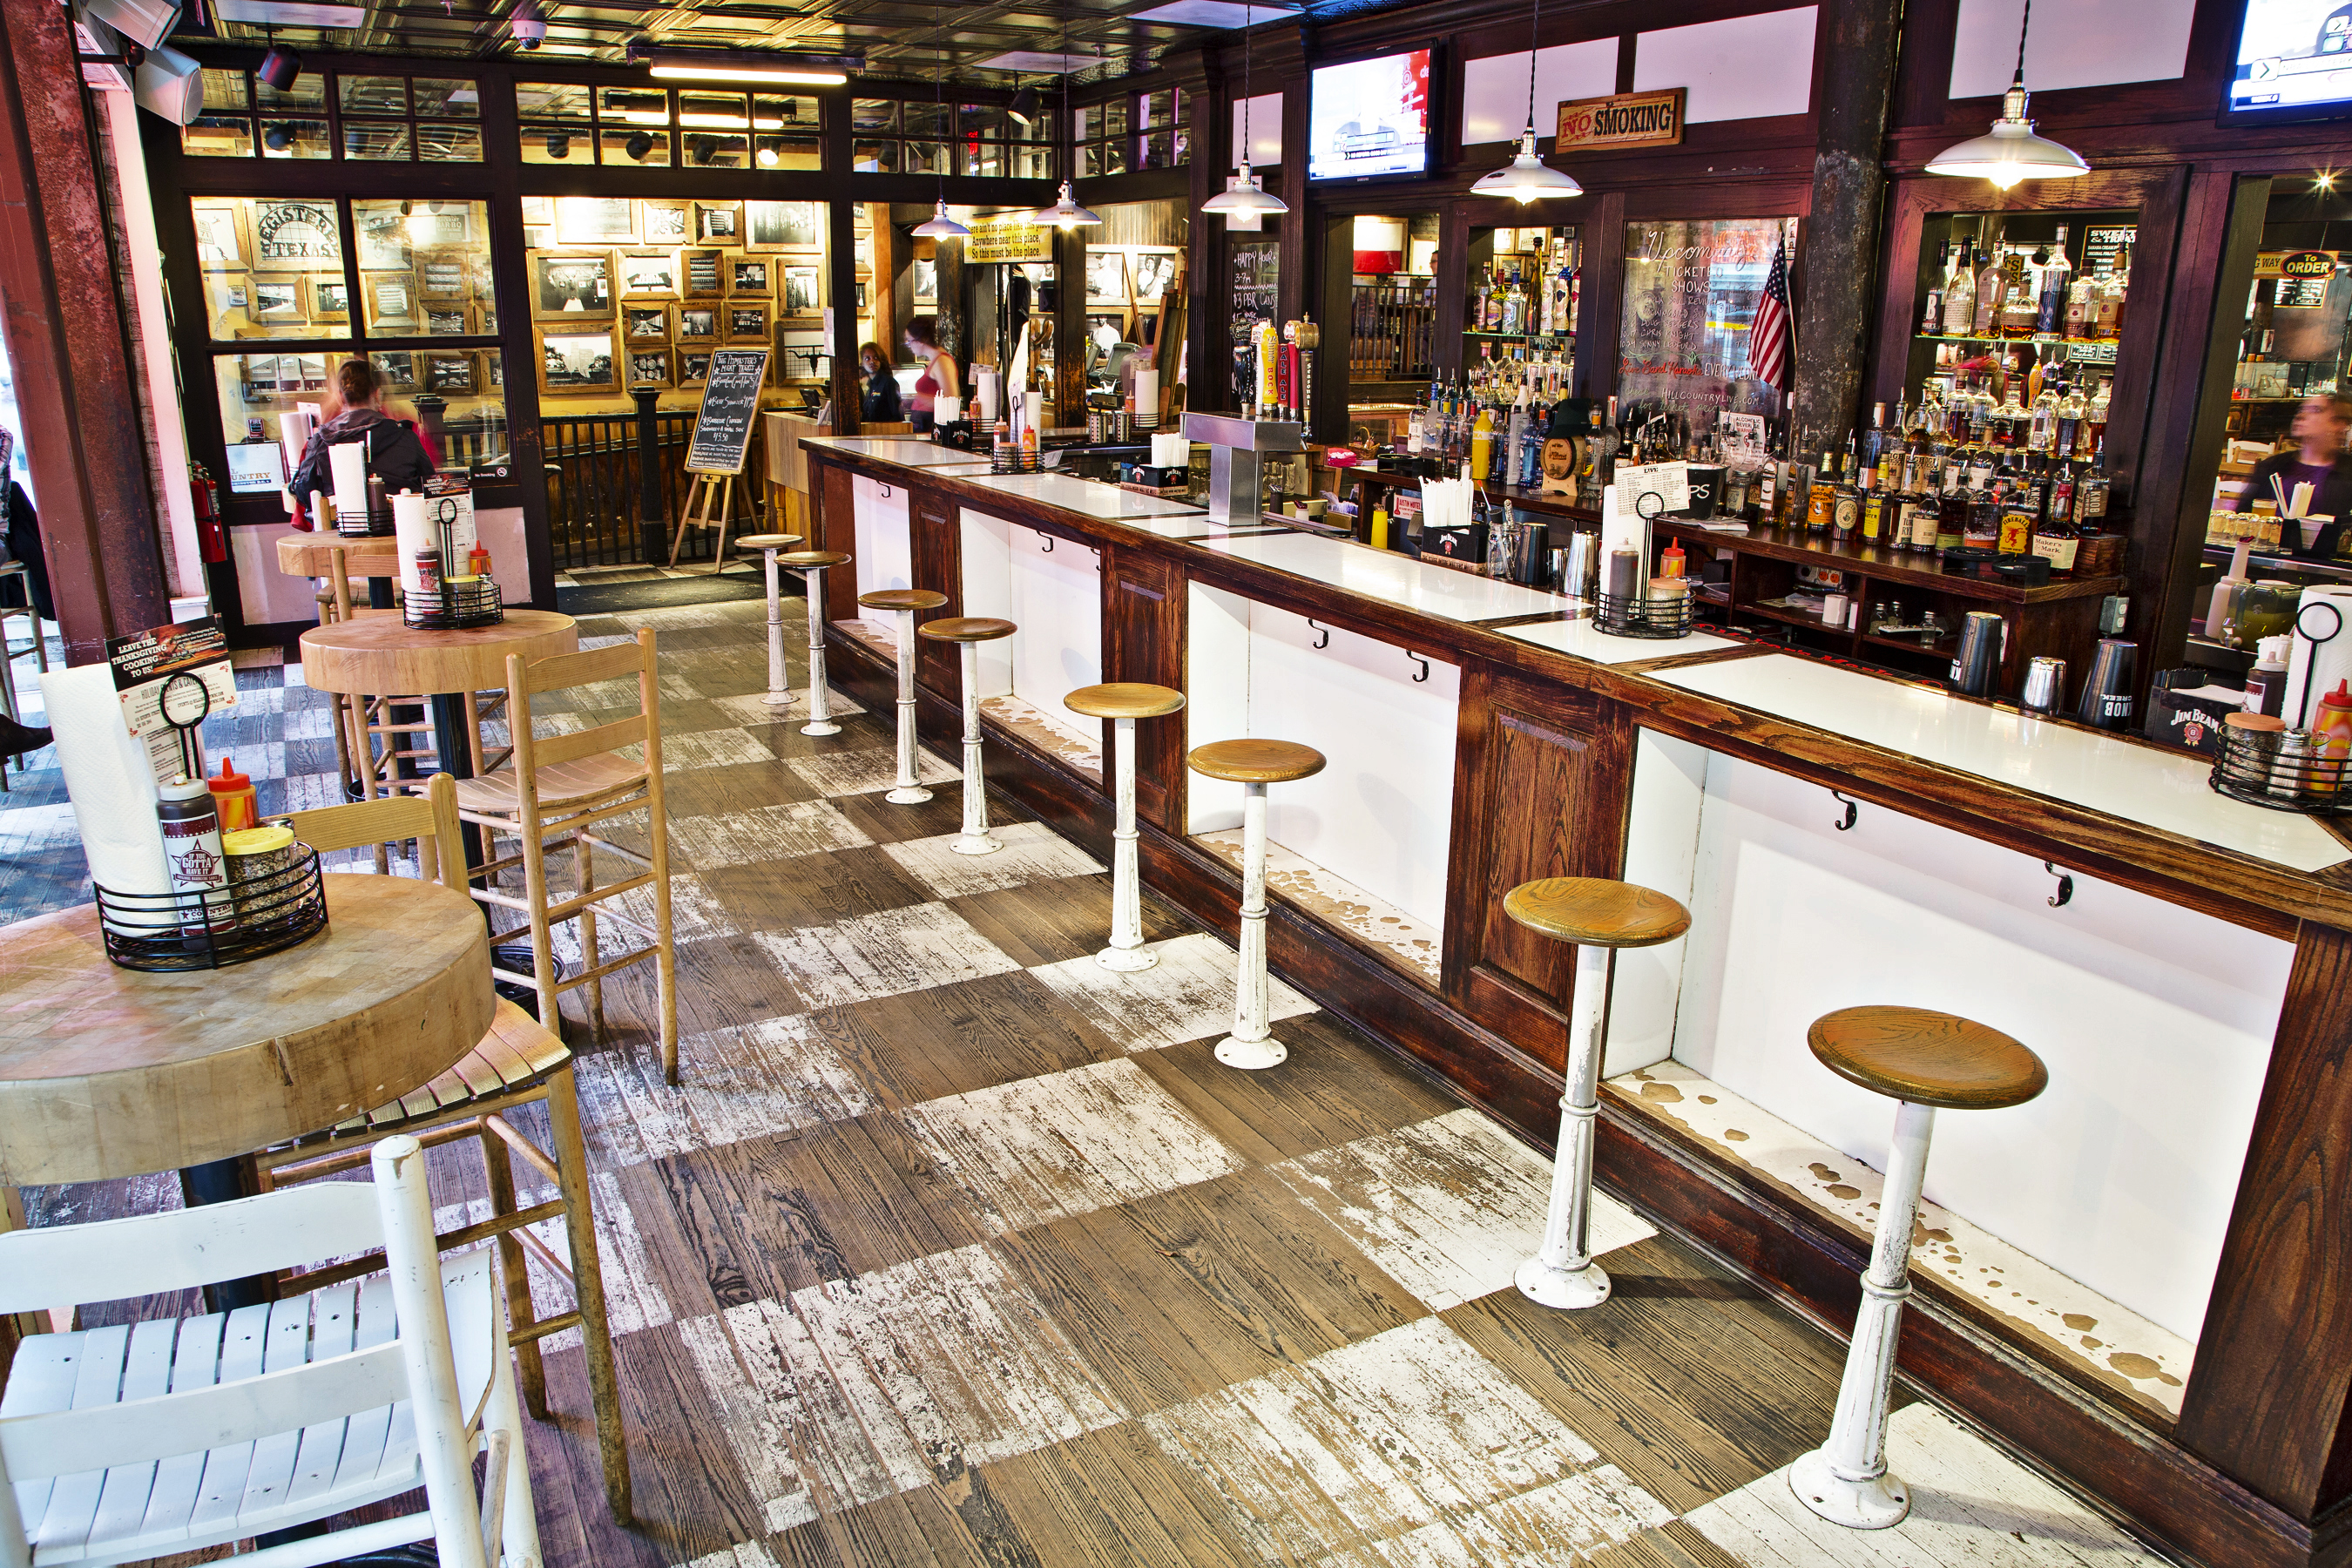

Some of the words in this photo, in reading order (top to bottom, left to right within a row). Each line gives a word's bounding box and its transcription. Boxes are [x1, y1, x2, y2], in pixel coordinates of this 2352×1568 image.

[1562, 115, 1592, 138] NO
[1594, 103, 1671, 136] SMOKING
[979, 221, 990, 233] ain't
[992, 224, 997, 233] no
[999, 220, 1012, 234] place
[1013, 220, 1023, 231] like
[1024, 219, 1034, 230] this
[972, 235, 998, 248] Anywhere
[999, 235, 1010, 245] near
[1012, 233, 1023, 244] this
[1024, 232, 1040, 246] place,
[272, 241, 335, 257] TEXAS
[972, 248, 978, 259] So
[979, 247, 990, 259] this
[990, 248, 1004, 258] must
[1005, 247, 1011, 257] be
[1013, 247, 1022, 257] the
[1024, 246, 1041, 260] place.
[1648, 231, 1747, 272] Upcoming
[1238, 249, 1257, 273] HAPPY
[1258, 248, 1277, 268] HOUR
[2264, 257, 2281, 267] WAY
[2287, 261, 2329, 274] ORDER
[1664, 266, 1723, 278] TICKETED
[1672, 280, 1711, 294] SHOWS
[1233, 292, 1242, 309] $3
[1243, 292, 1259, 311] PBR
[1260, 292, 1276, 309] CANS
[1926, 294, 1937, 320] B
[1693, 308, 1713, 319] SUN
[1640, 329, 1662, 338] CHRIS
[1665, 330, 1695, 341] KNIGHT
[717, 355, 727, 364] THE
[727, 355, 757, 365] PITMASTER'S
[720, 364, 736, 373] MEAT
[1619, 357, 1640, 377] Live
[1641, 360, 1667, 375] Band
[1667, 362, 1705, 380] Karaoke
[1705, 362, 1732, 378] EVERY
[1638, 398, 1652, 415] for
[231, 472, 271, 481] UNTRY
[1399, 498, 1409, 507] AUSTIN
[1409, 500, 1421, 510] MOTEL
[2088, 490, 2101, 514] KNOB
[2003, 516, 2029, 528] FIREBALL
[2035, 537, 2063, 548] Maker's
[2040, 545, 2061, 554] Mark
[118, 641, 143, 654] LEAVE
[143, 637, 158, 649] THE
[111, 644, 168, 666] THANKSGIVING
[123, 655, 159, 672] COOKING
[131, 669, 143, 679] TO
[142, 665, 154, 675] US!
[140, 685, 160, 700] HOLIDAY
[178, 679, 184, 688] &
[183, 672, 207, 689] CATENG
[2170, 709, 2191, 727] JIM
[2191, 707, 2220, 734] BEAM
[181, 858, 213, 869] GOTTA
[191, 903, 232, 918] CONTRY
